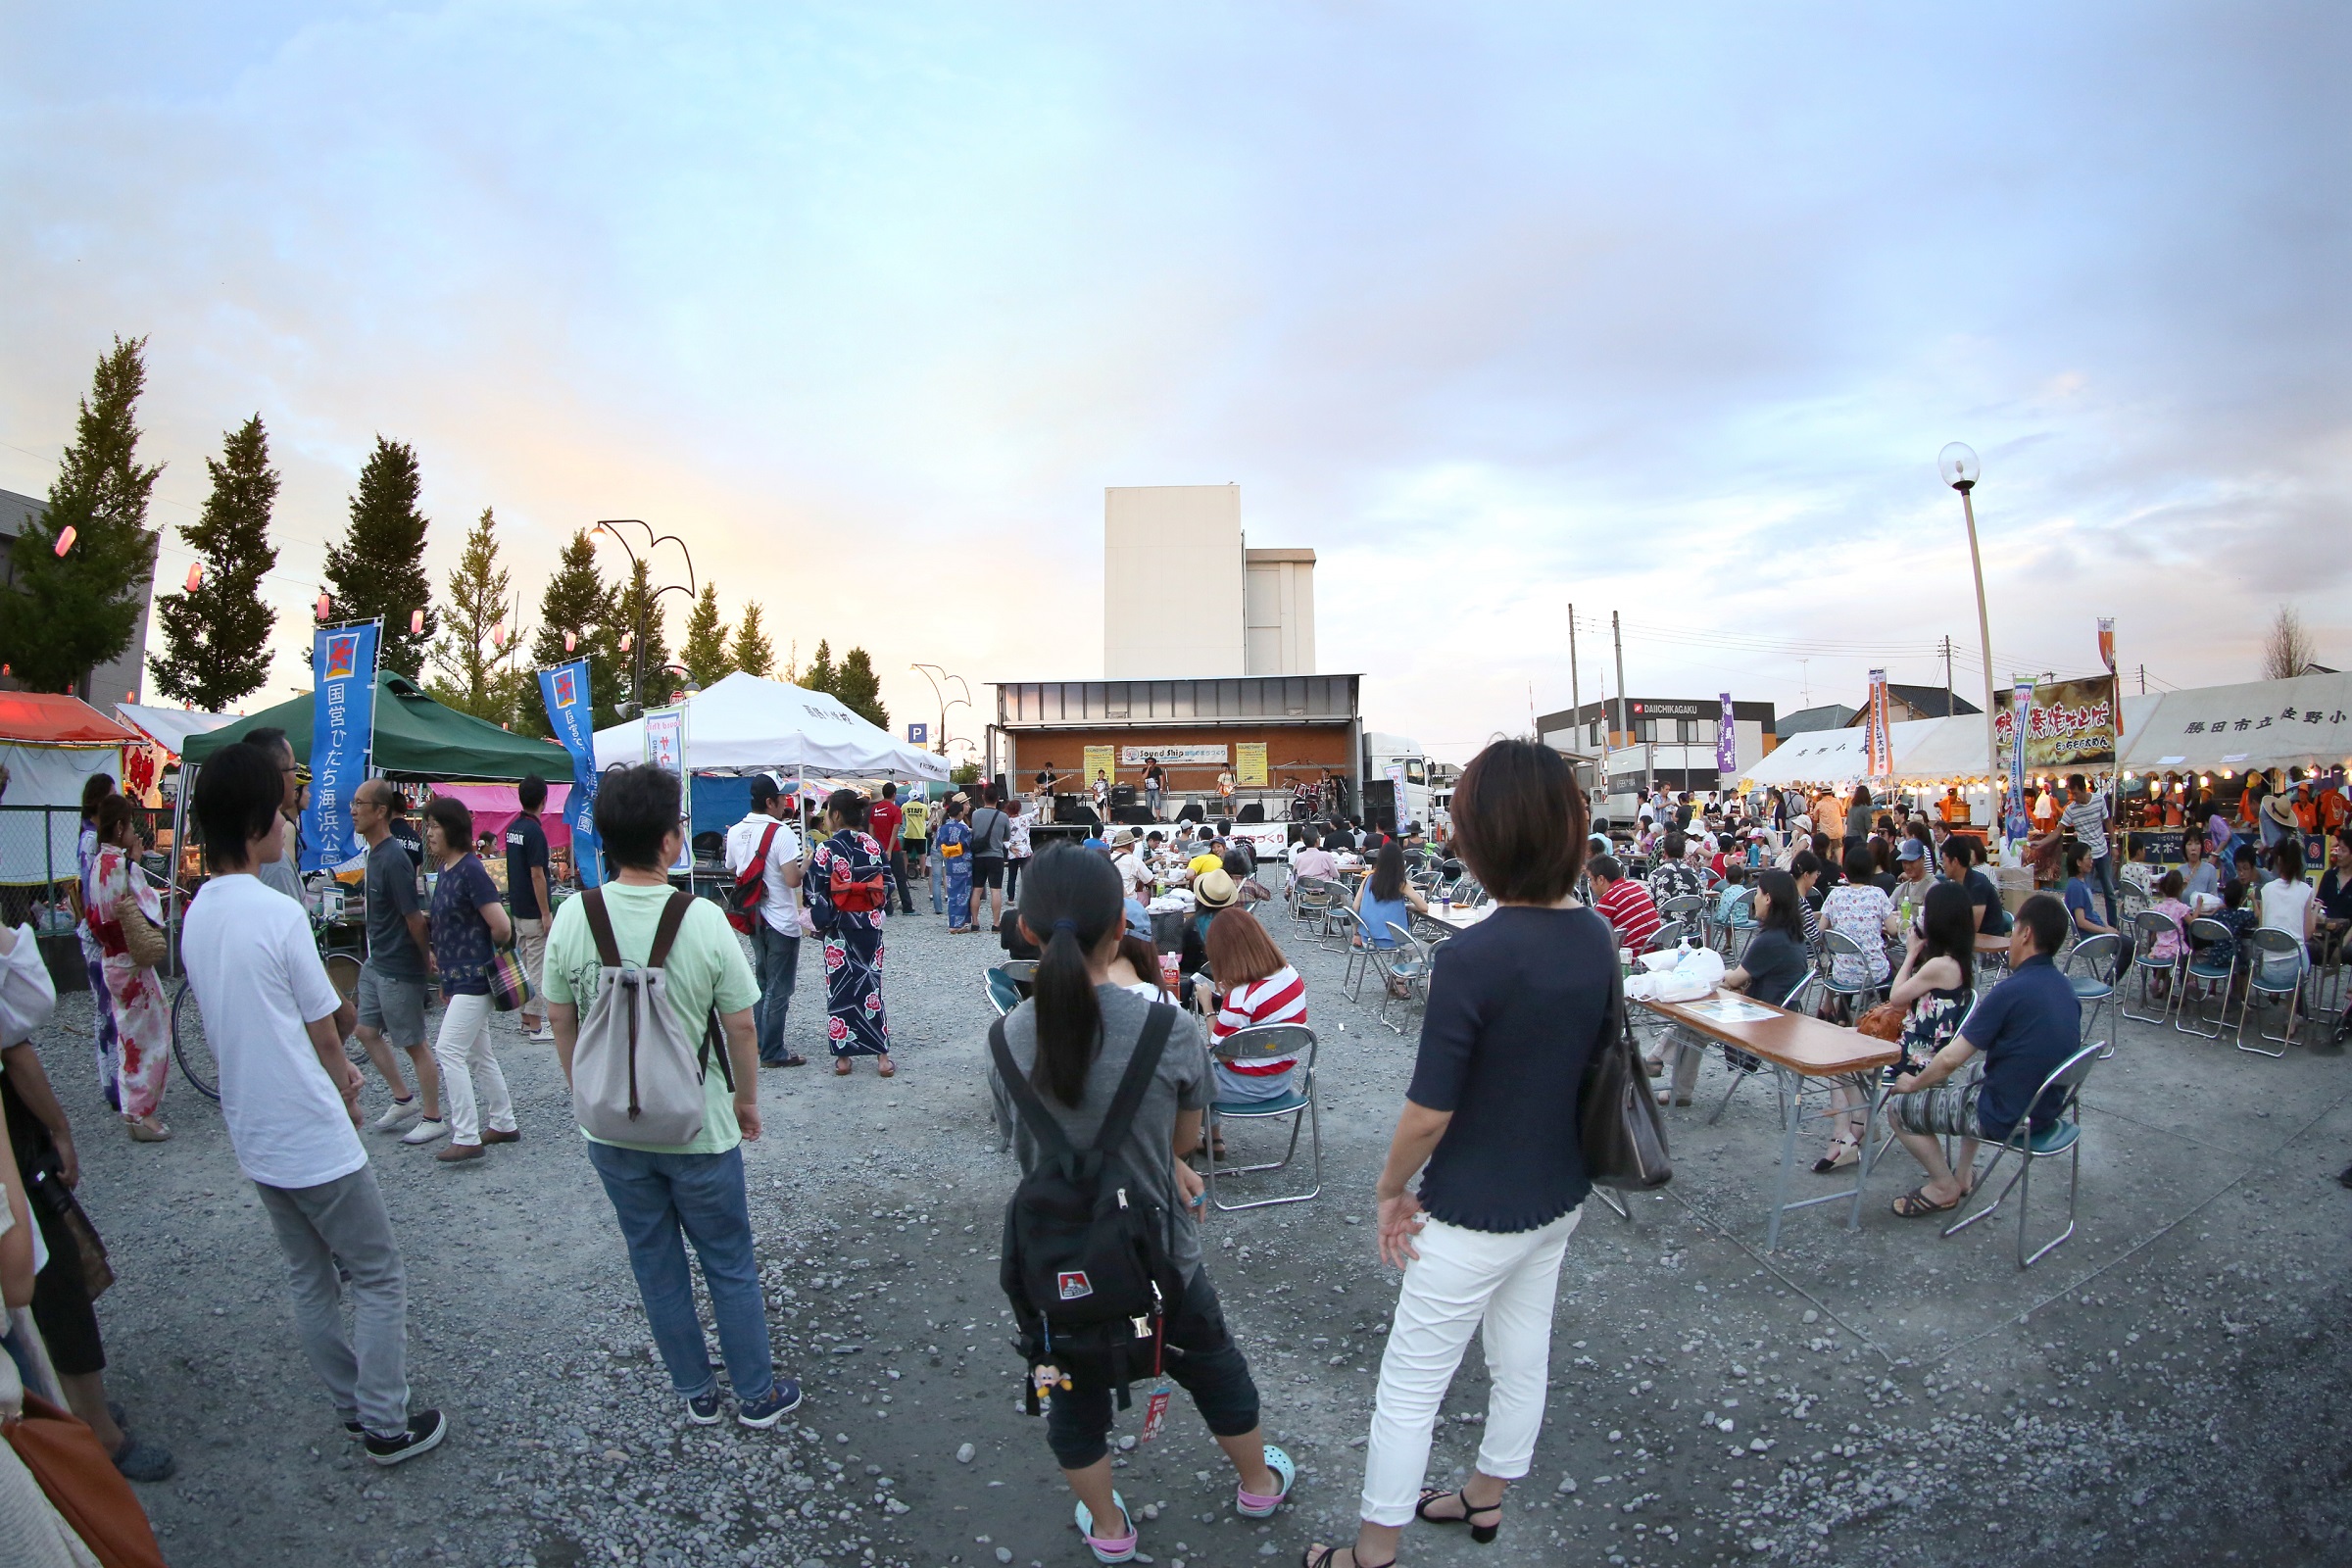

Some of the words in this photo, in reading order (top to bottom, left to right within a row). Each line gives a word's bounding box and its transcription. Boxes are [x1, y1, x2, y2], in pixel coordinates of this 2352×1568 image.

[1643, 704, 1697, 714] DAIICHIKAGAKU
[1994, 701, 2110, 743] 那湊焼きそば
[912, 727, 922, 741] P
[1166, 749, 1184, 758] Ship
[318, 682, 347, 865] 国営ひたち海浜公園
